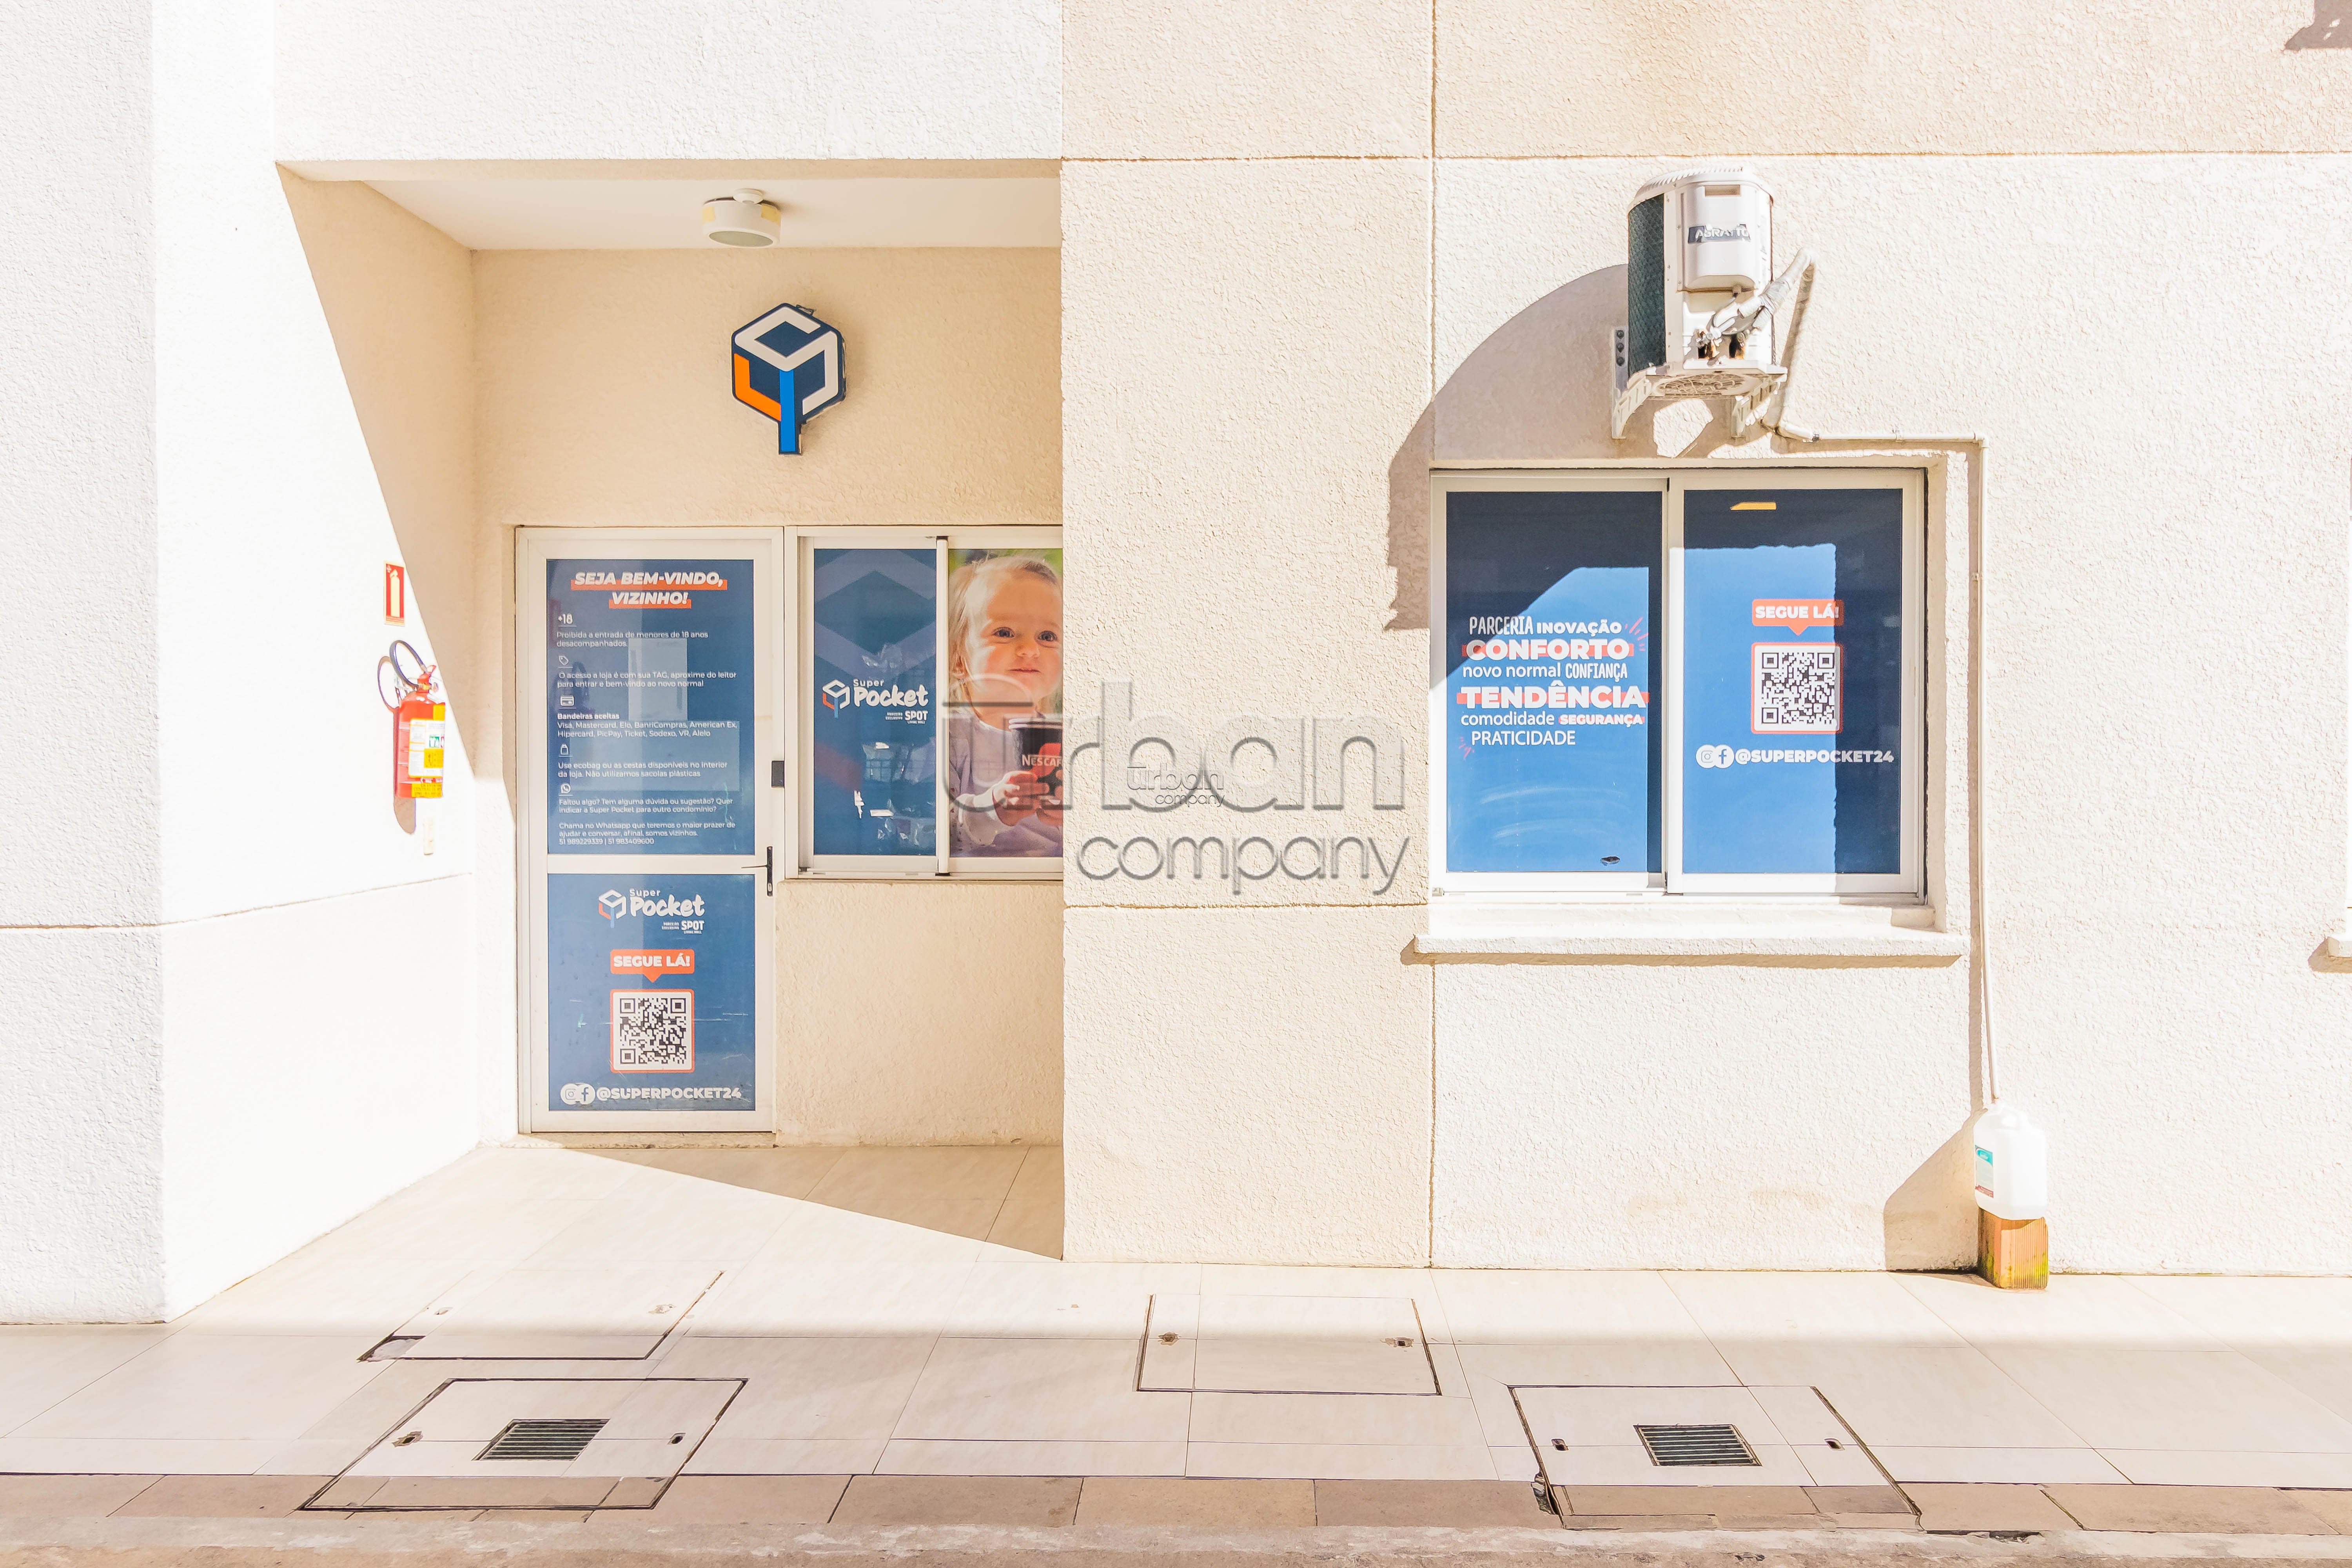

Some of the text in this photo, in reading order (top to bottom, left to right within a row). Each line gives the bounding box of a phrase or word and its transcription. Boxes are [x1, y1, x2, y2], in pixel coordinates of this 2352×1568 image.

[575, 572, 723, 587] SEJA BEM-VINDO,
[613, 592, 689, 605] VIZINHO!
[1755, 603, 1839, 619] SEGUE LÁ!
[558, 613, 573, 624] +18
[1469, 616, 1622, 636] PARCERIA INOVAÇÃO
[1466, 639, 1629, 660] CONFORTO
[1463, 662, 1628, 682] novo normal CONFIANÇA
[853, 679, 884, 688] Super
[854, 685, 928, 706] Pocket
[1461, 680, 1646, 709] TENDÊNCIA
[905, 710, 928, 720] SPOT
[1461, 711, 1642, 727] comodidade SEGURANÇA
[1472, 730, 1575, 745] PRATICIDADE
[1022, 755, 1062, 766] NESCAF
[1735, 749, 1894, 762] @SUPERPOCKET24
[573, 762, 601, 770] ecobag
[569, 770, 584, 779] loja.
[630, 889, 660, 897] Super
[630, 894, 705, 917] Pocket
[681, 920, 704, 930] SPOT
[613, 954, 690, 967] SEGUE LÁ!
[596, 1087, 742, 1100] @SUPERPOCKET24
